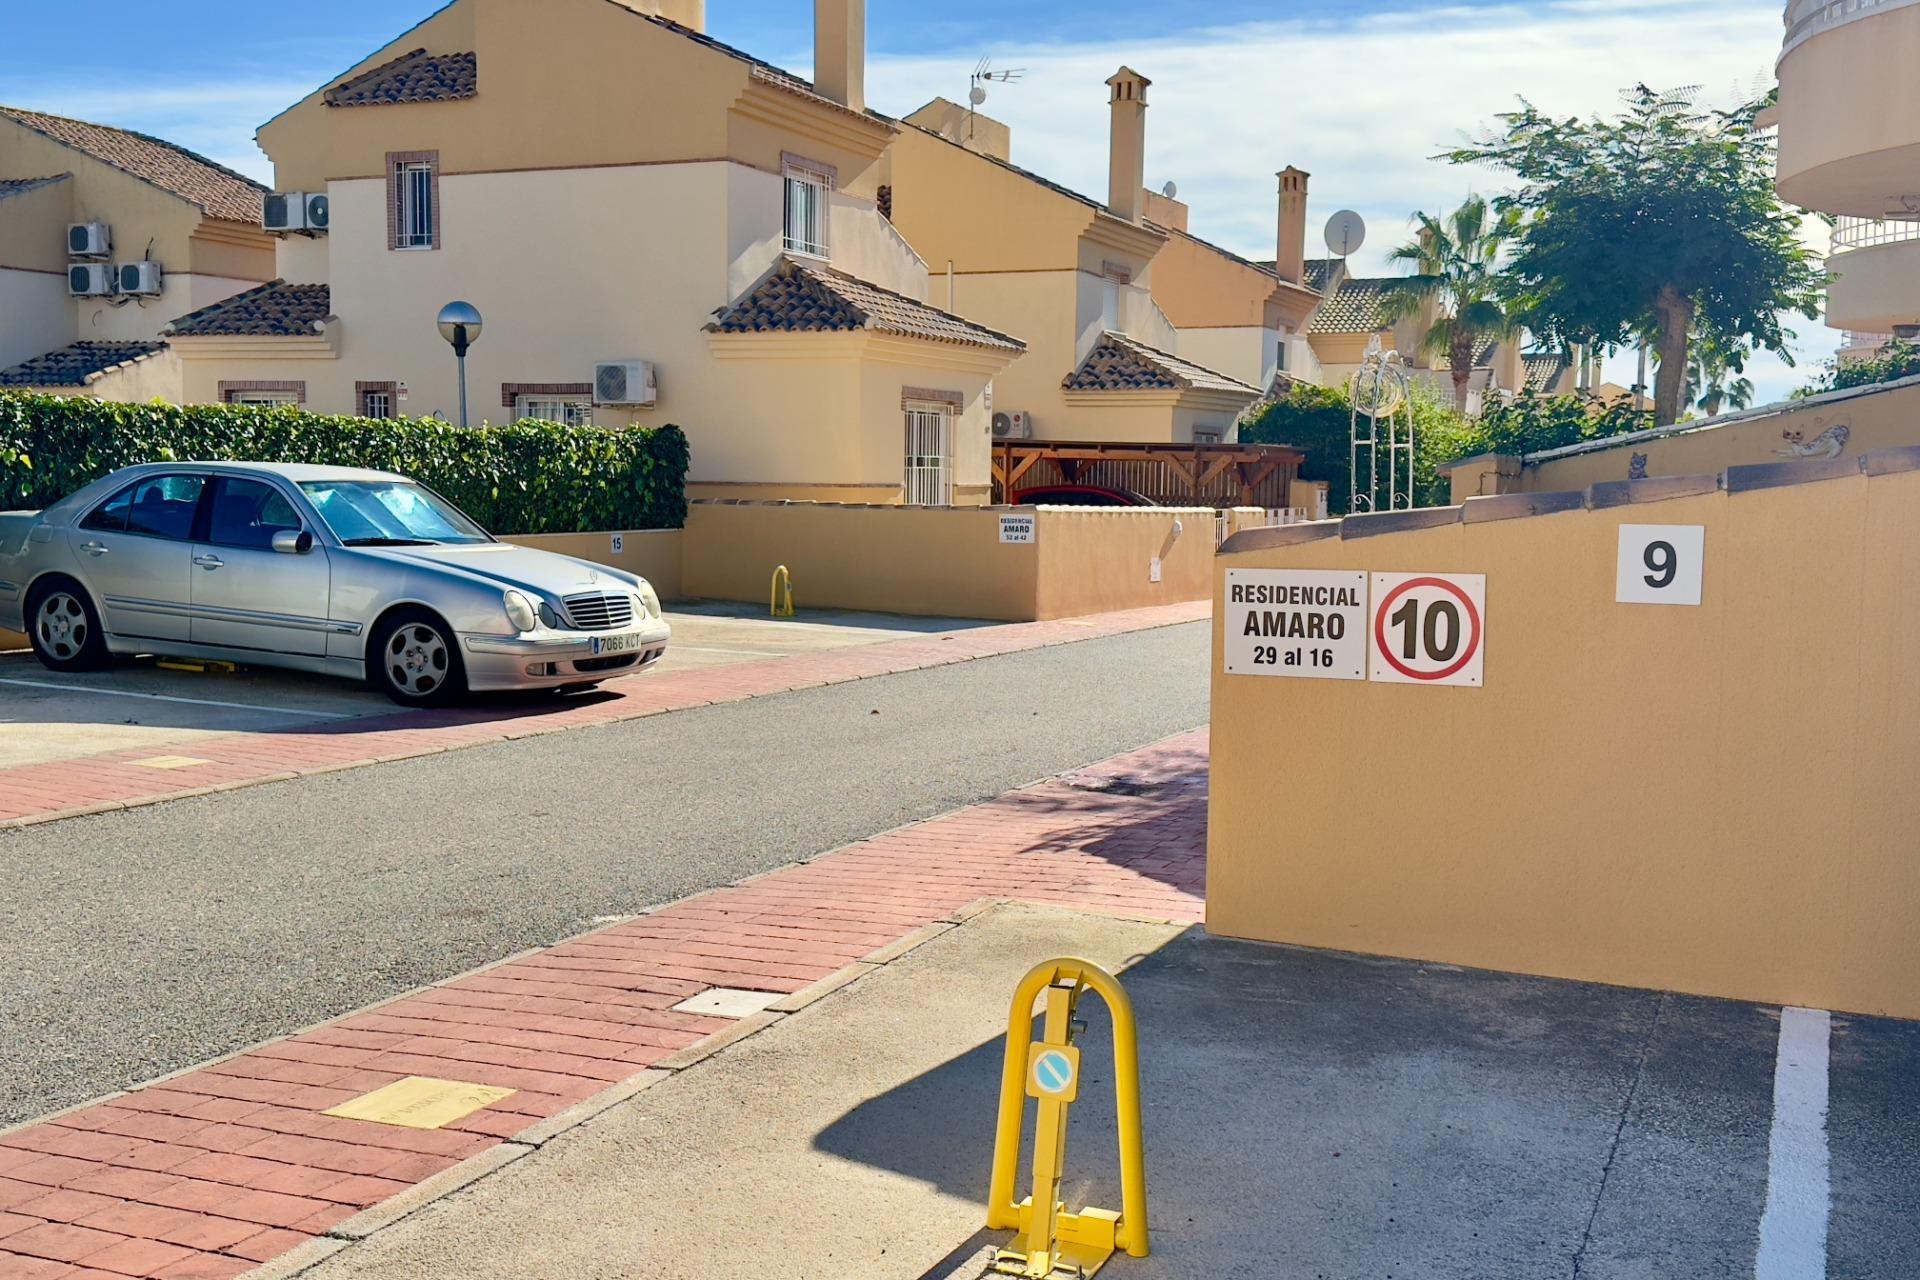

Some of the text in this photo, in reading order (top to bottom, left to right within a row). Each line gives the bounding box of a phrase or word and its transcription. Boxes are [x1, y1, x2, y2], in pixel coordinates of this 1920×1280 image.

[1003, 525, 1030, 533] AMARO
[612, 537, 622, 551] 15
[1643, 540, 1677, 589] 9
[1231, 584, 1360, 607] RESIDENCIAL
[1243, 610, 1345, 640] AMARO
[1391, 598, 1461, 662] 10
[601, 633, 640, 651] 7066 KCT
[1253, 645, 1333, 667] 29 al 16
